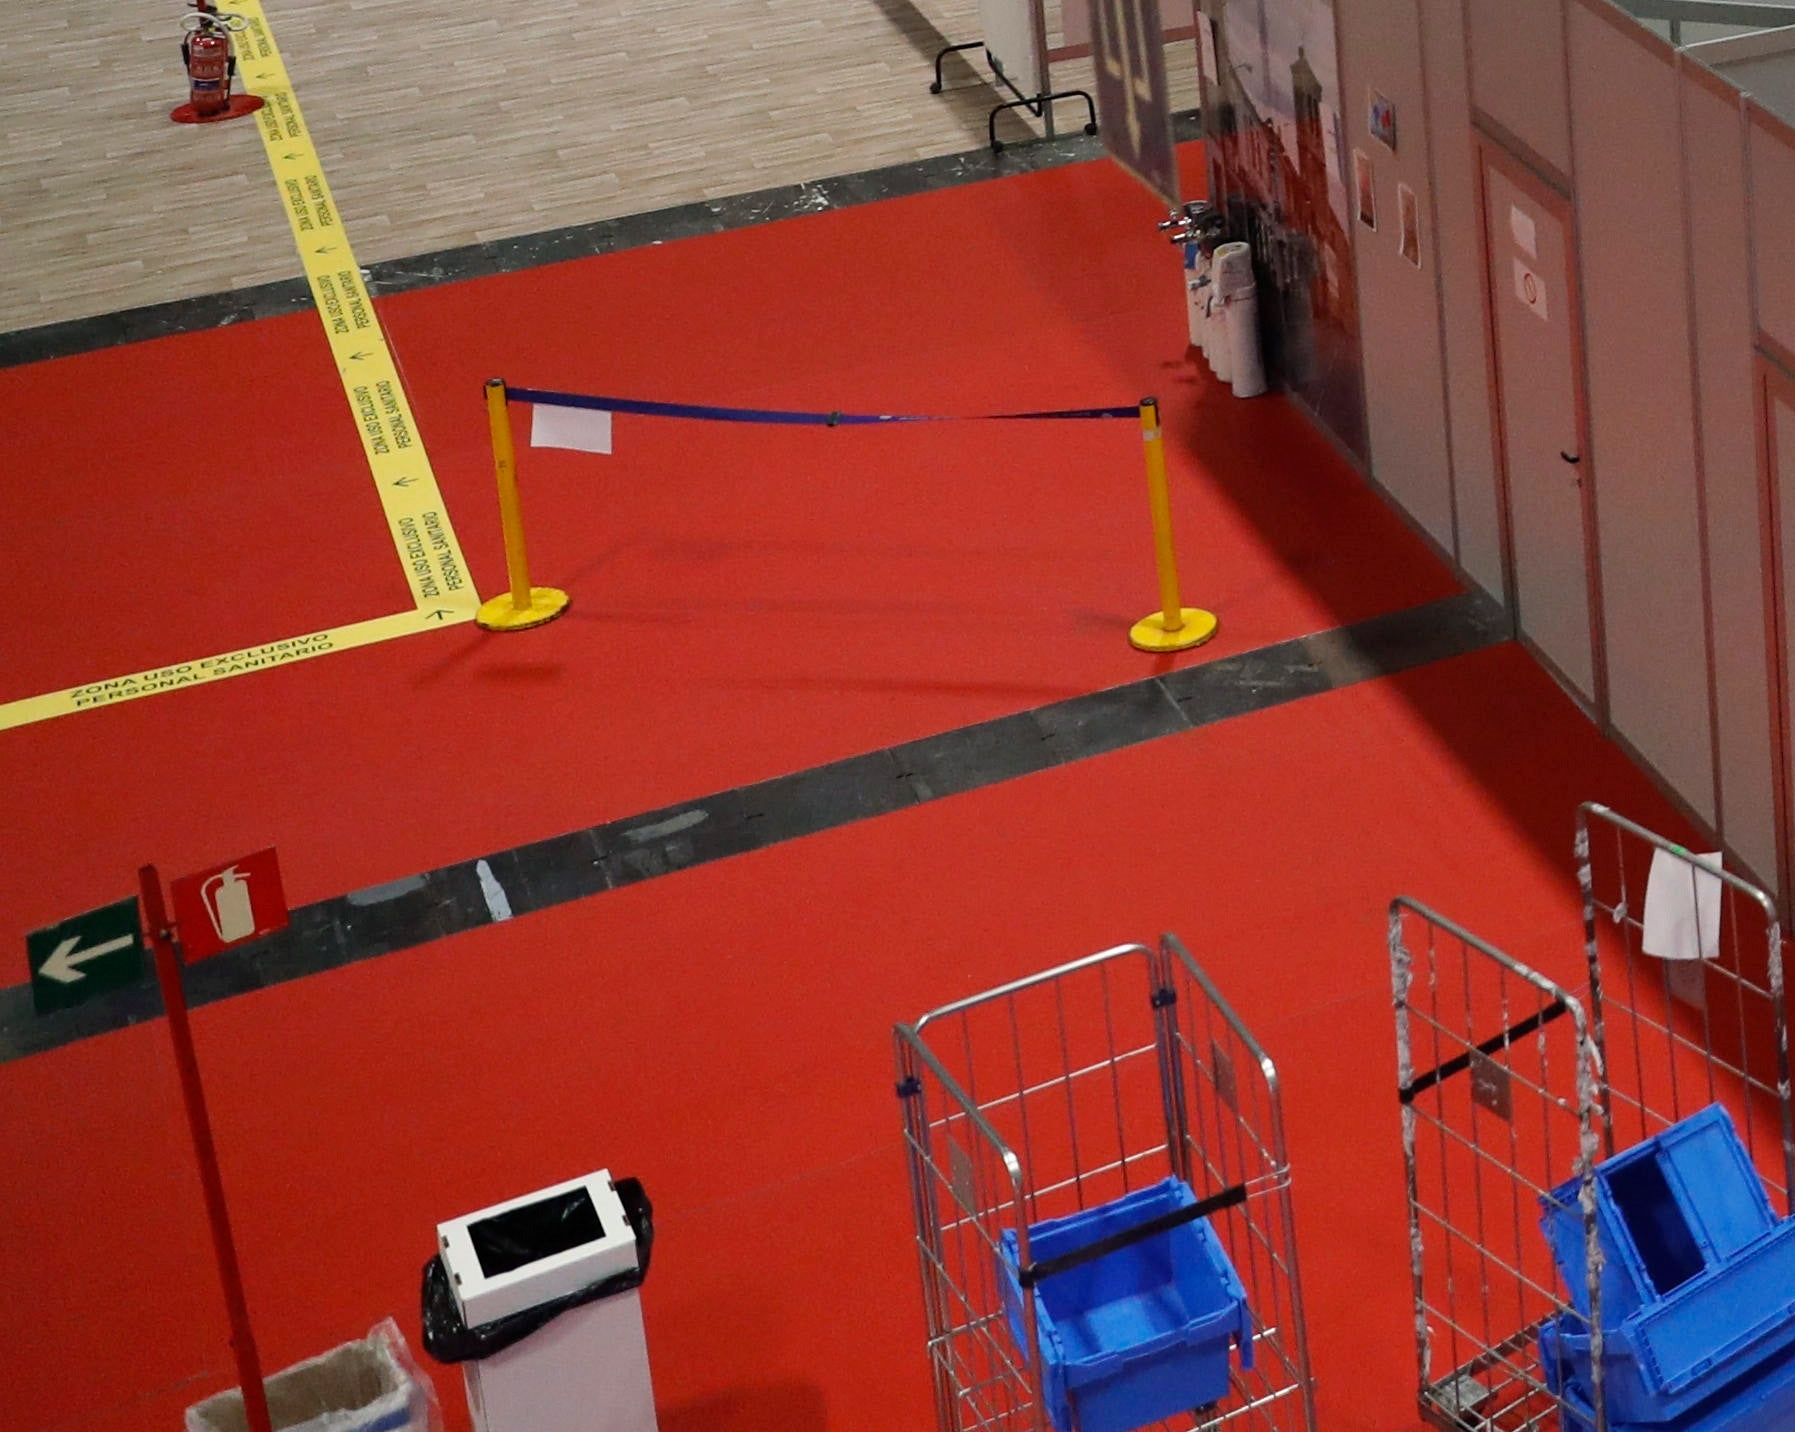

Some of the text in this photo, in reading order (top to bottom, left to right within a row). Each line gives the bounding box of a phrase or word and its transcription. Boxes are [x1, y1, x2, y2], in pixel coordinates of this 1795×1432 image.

[353, 385, 390, 454] ZONA USO EXCLUSIVO
[374, 380, 412, 448] PERSONAL SANITARIO
[397, 516, 439, 597] ZONA USO EXCLUSIVO
[420, 511, 464, 591] PERSONAL SANITARIO
[71, 634, 329, 698] ZONA USO EXCLUSIVO
[77, 641, 334, 707] PERSONAL SANITARIO
